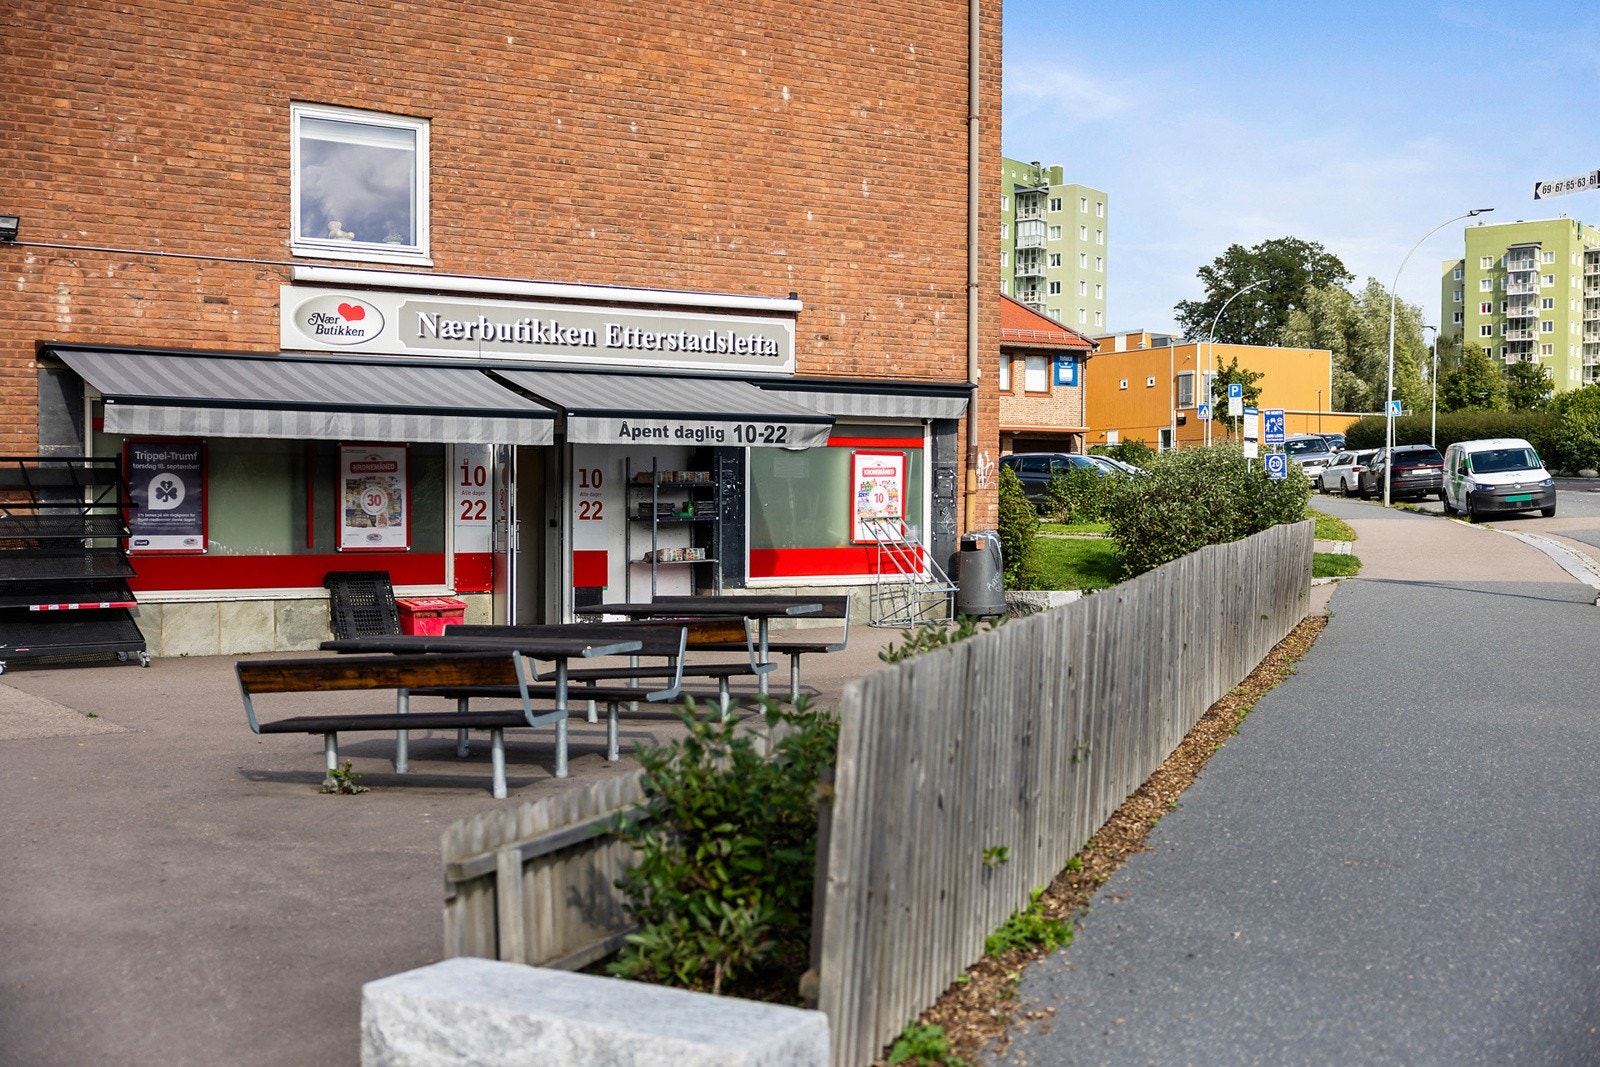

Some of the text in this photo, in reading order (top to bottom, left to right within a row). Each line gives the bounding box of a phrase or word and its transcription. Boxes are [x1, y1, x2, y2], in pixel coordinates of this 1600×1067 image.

[307, 312, 341, 326] Nær
[315, 323, 365, 337] Butikken
[415, 311, 779, 357] Nærbutikken Etterstadsletta
[1231, 386, 1239, 397] P
[618, 421, 788, 444] Åpent daglig 10-22
[134, 450, 199, 462] Trippel-Trumf
[132, 463, 157, 471] torsdag
[1271, 460, 1281, 468] 20
[460, 465, 487, 488] 10
[578, 468, 603, 489] 10
[367, 494, 382, 507] 30
[874, 492, 884, 504] 10
[460, 499, 487, 521] 22
[578, 500, 604, 521] 22
